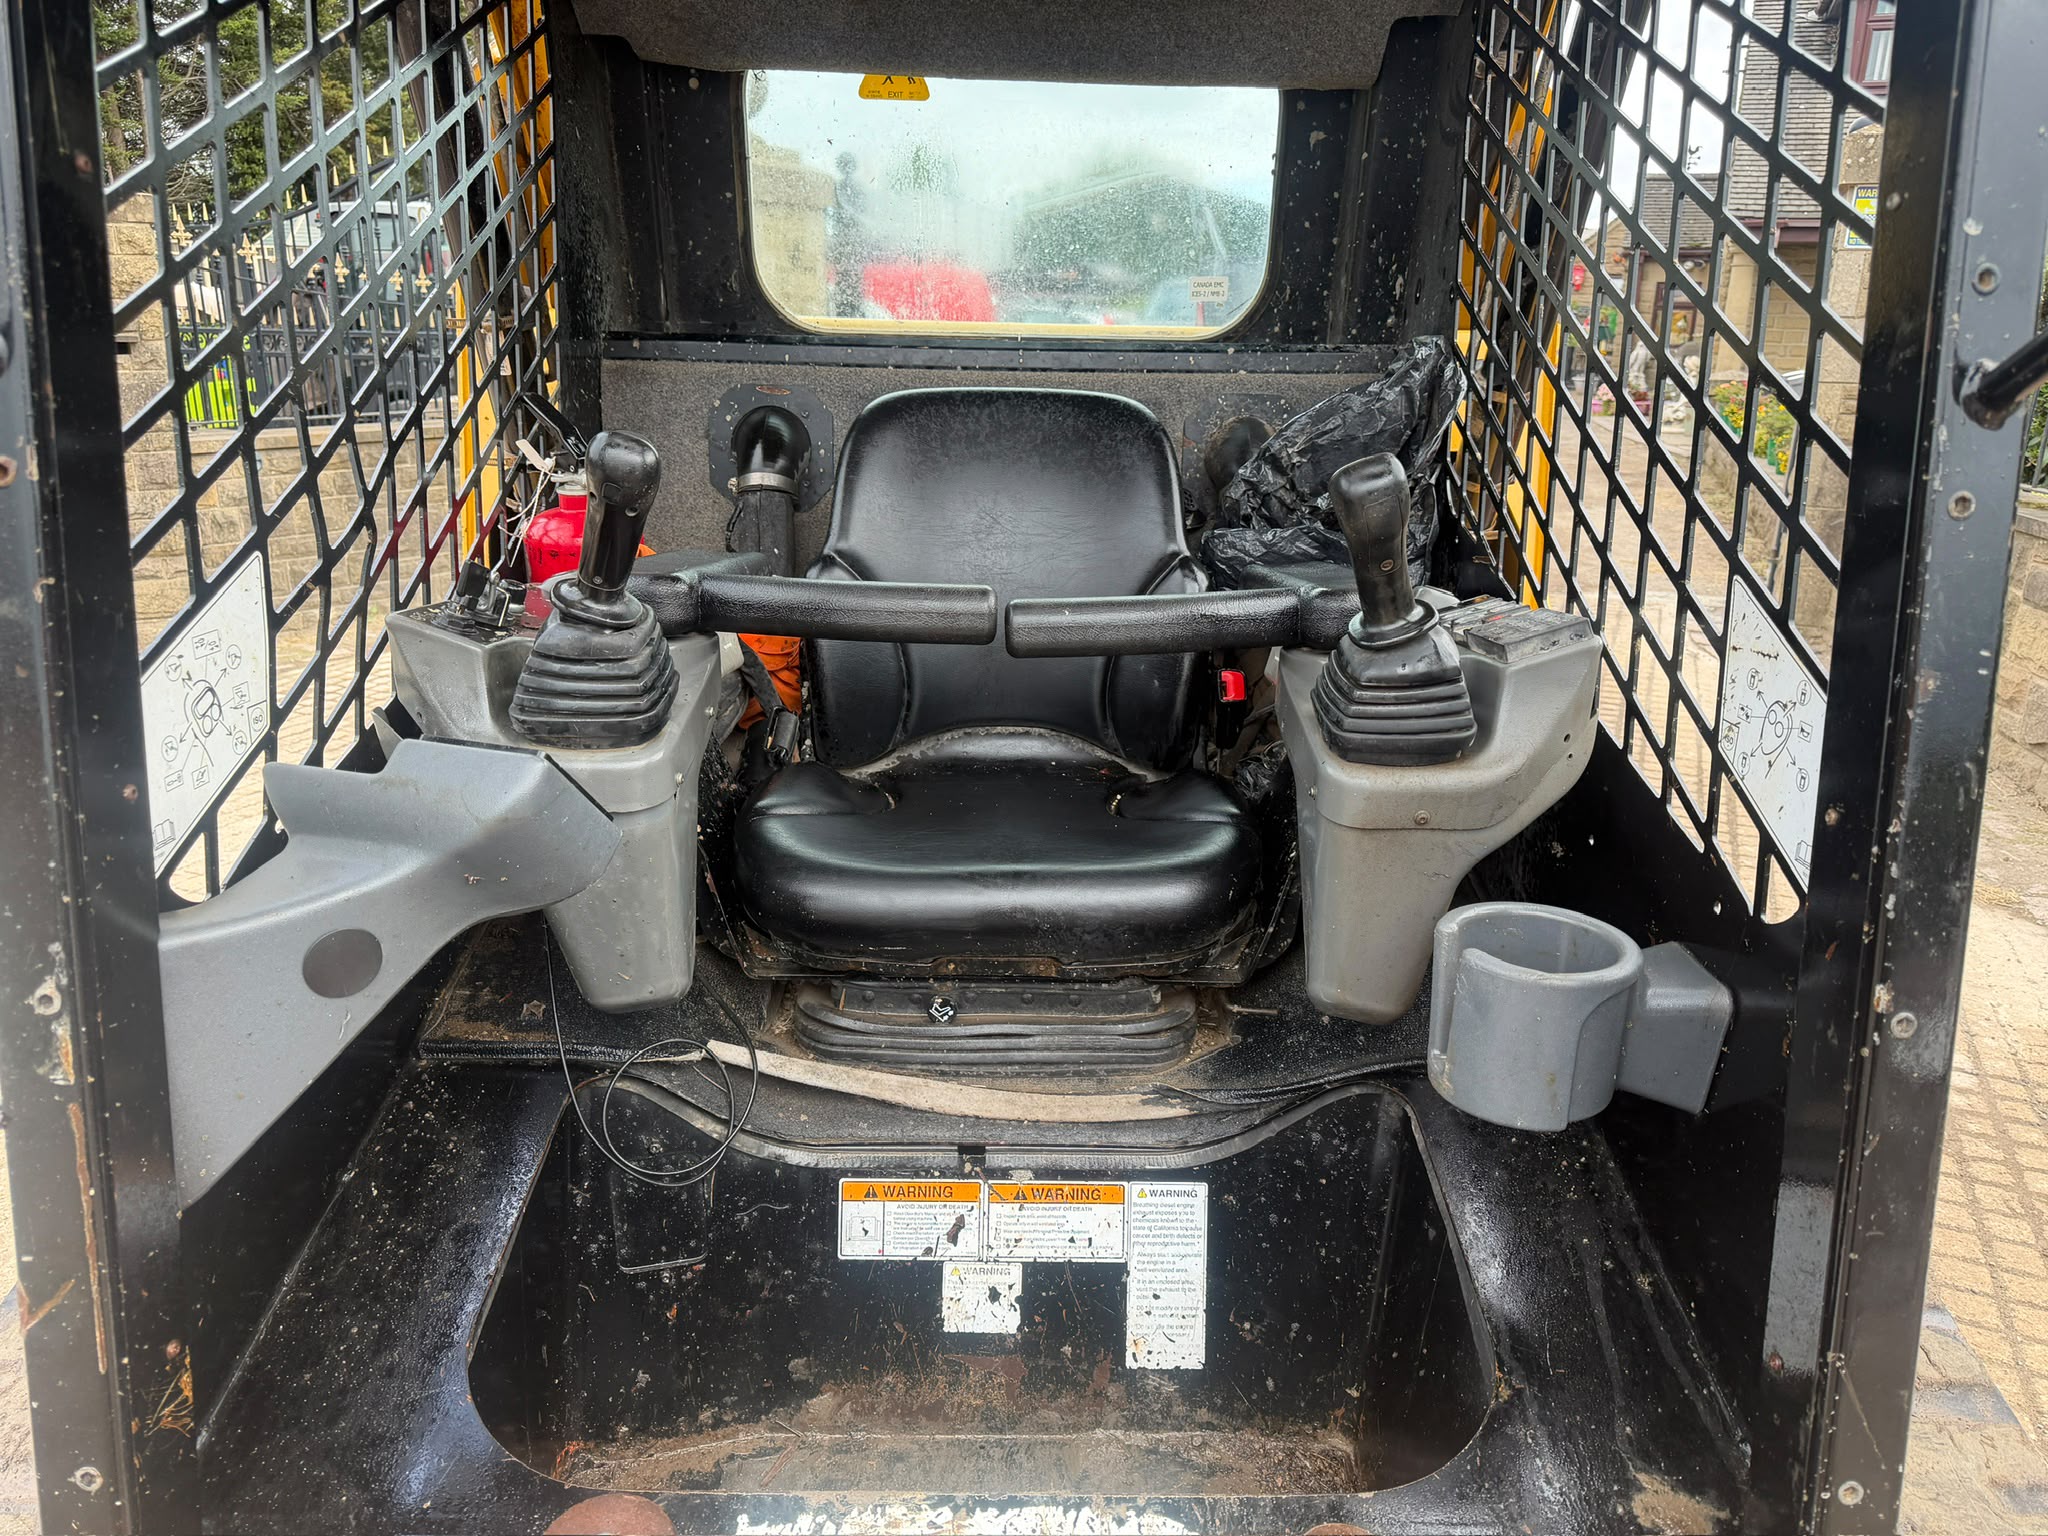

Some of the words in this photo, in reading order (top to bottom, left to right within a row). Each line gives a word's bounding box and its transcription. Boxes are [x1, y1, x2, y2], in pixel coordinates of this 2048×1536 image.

[1193, 281, 1213, 289] CANADA
[252, 714, 264, 725] ISO
[883, 1185, 953, 1199] WARNING
[1031, 1187, 1101, 1201] WARNING
[1149, 1189, 1198, 1199] WARNING
[1132, 1201, 1159, 1209] Breathing
[963, 1266, 1011, 1276] WARNING
